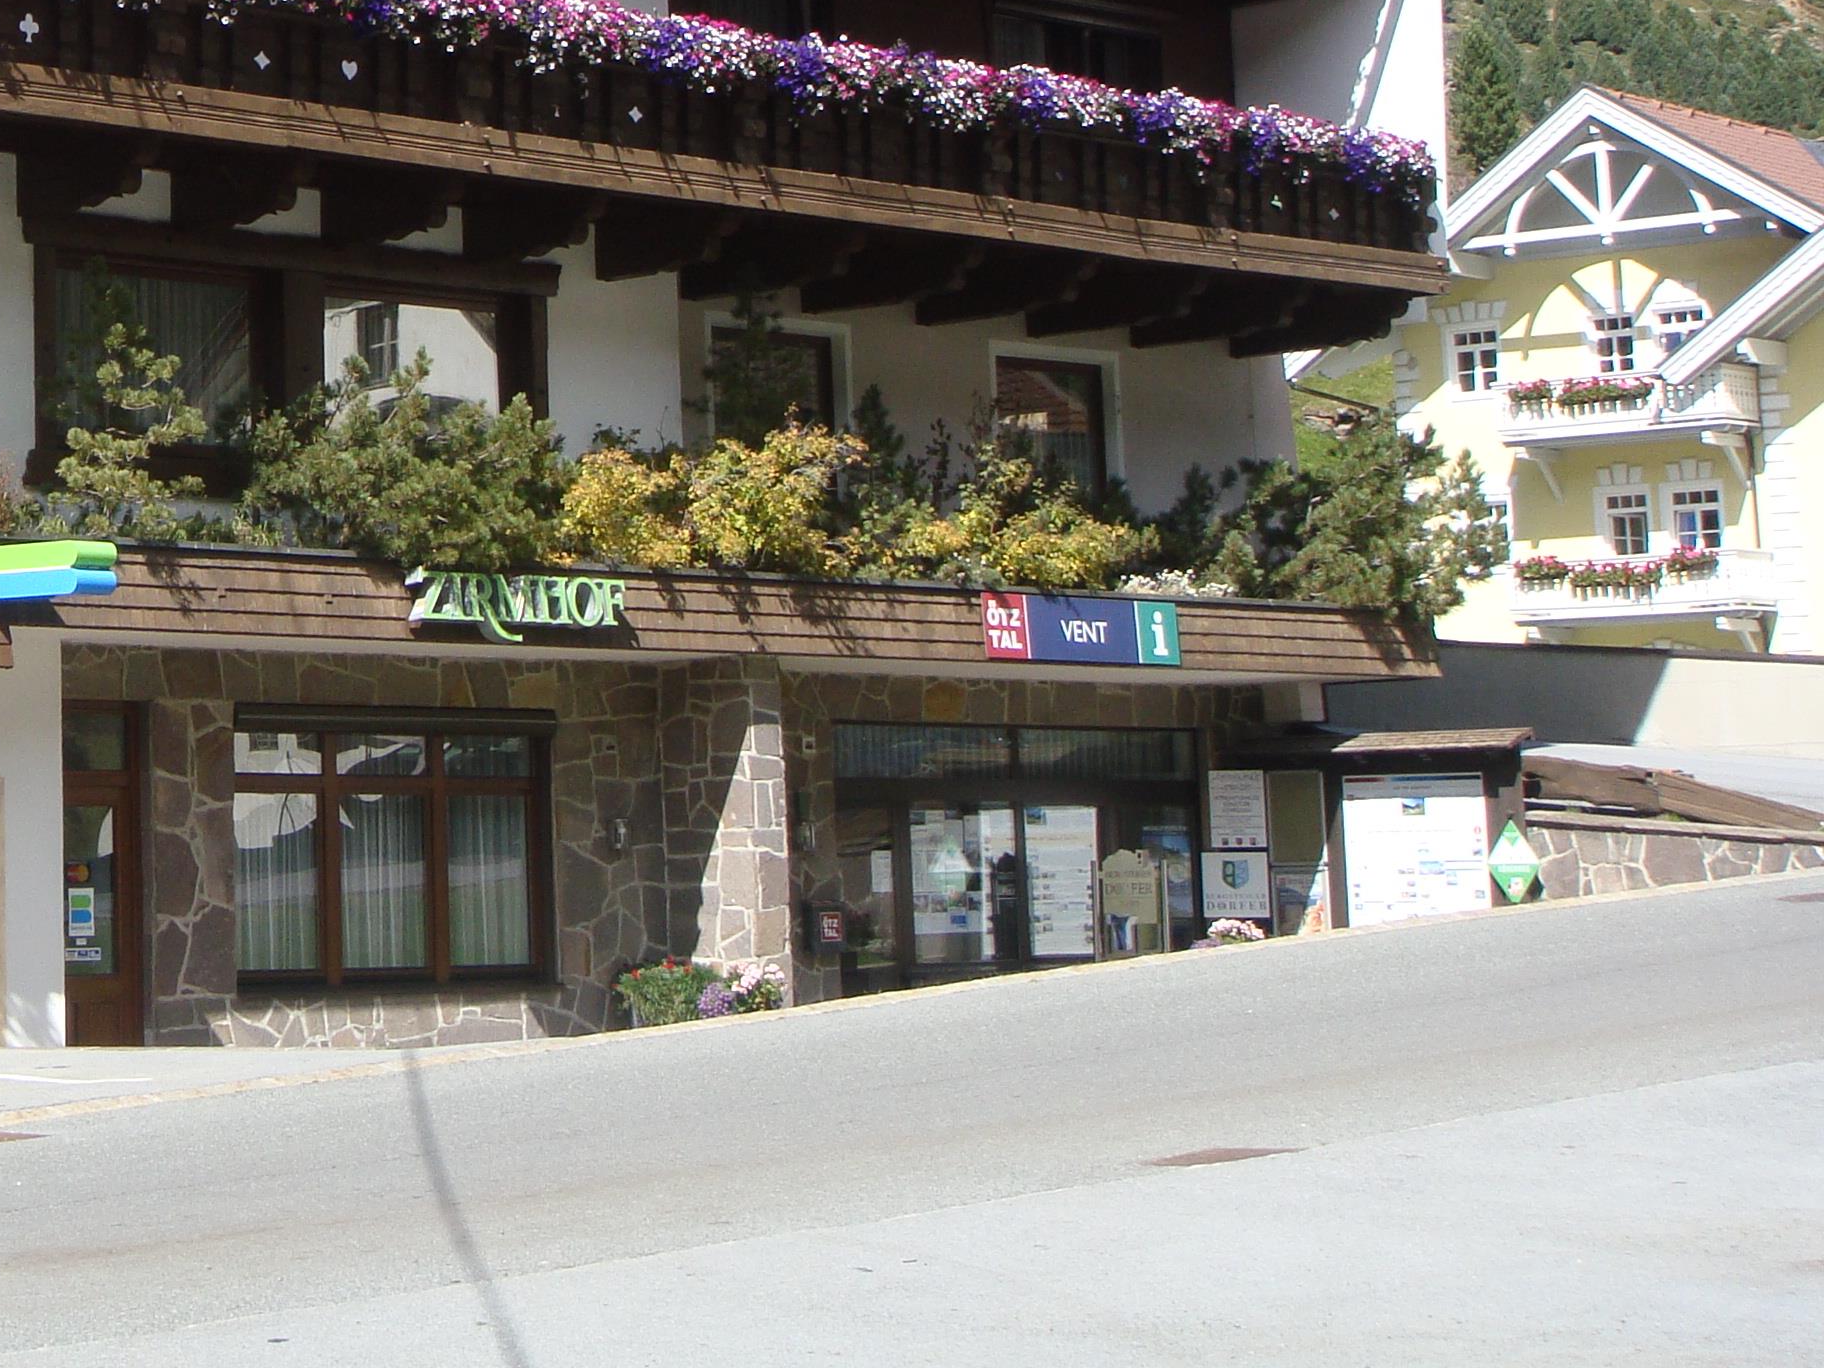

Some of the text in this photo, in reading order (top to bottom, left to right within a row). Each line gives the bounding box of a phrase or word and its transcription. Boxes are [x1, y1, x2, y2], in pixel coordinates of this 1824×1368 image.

[407, 567, 626, 642] ZIRMHOF
[986, 599, 1022, 628] ÖTZ
[988, 629, 1023, 650] TAL
[1060, 618, 1108, 644] VENT
